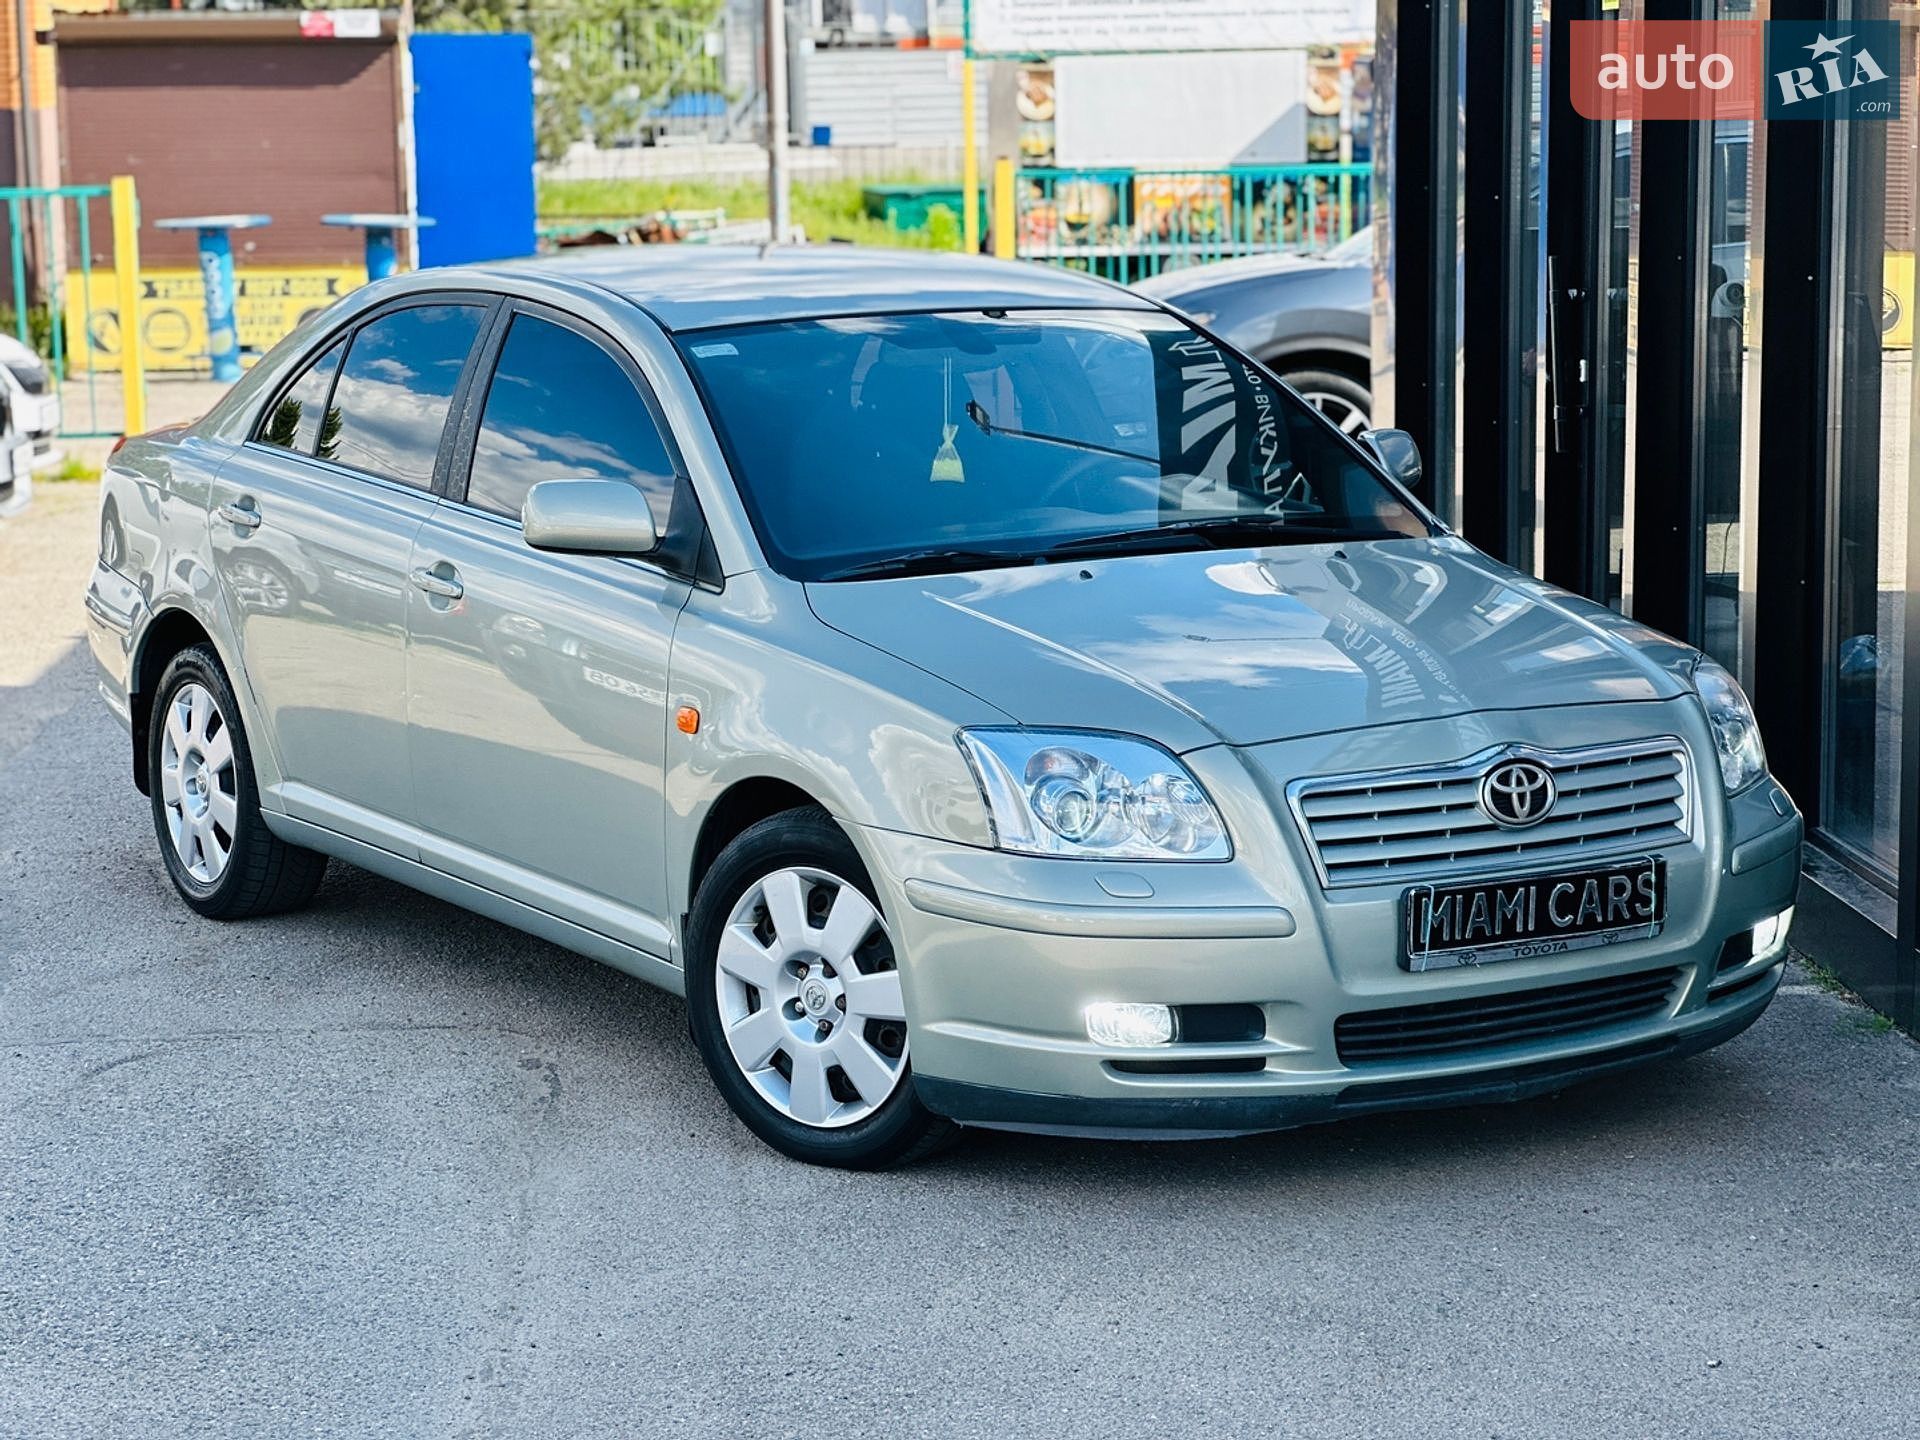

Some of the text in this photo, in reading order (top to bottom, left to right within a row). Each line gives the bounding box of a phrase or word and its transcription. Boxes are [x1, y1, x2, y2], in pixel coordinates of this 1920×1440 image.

[1420, 871, 1655, 943] MIAMI CARS
[1512, 942, 1569, 957] TOYOTA
